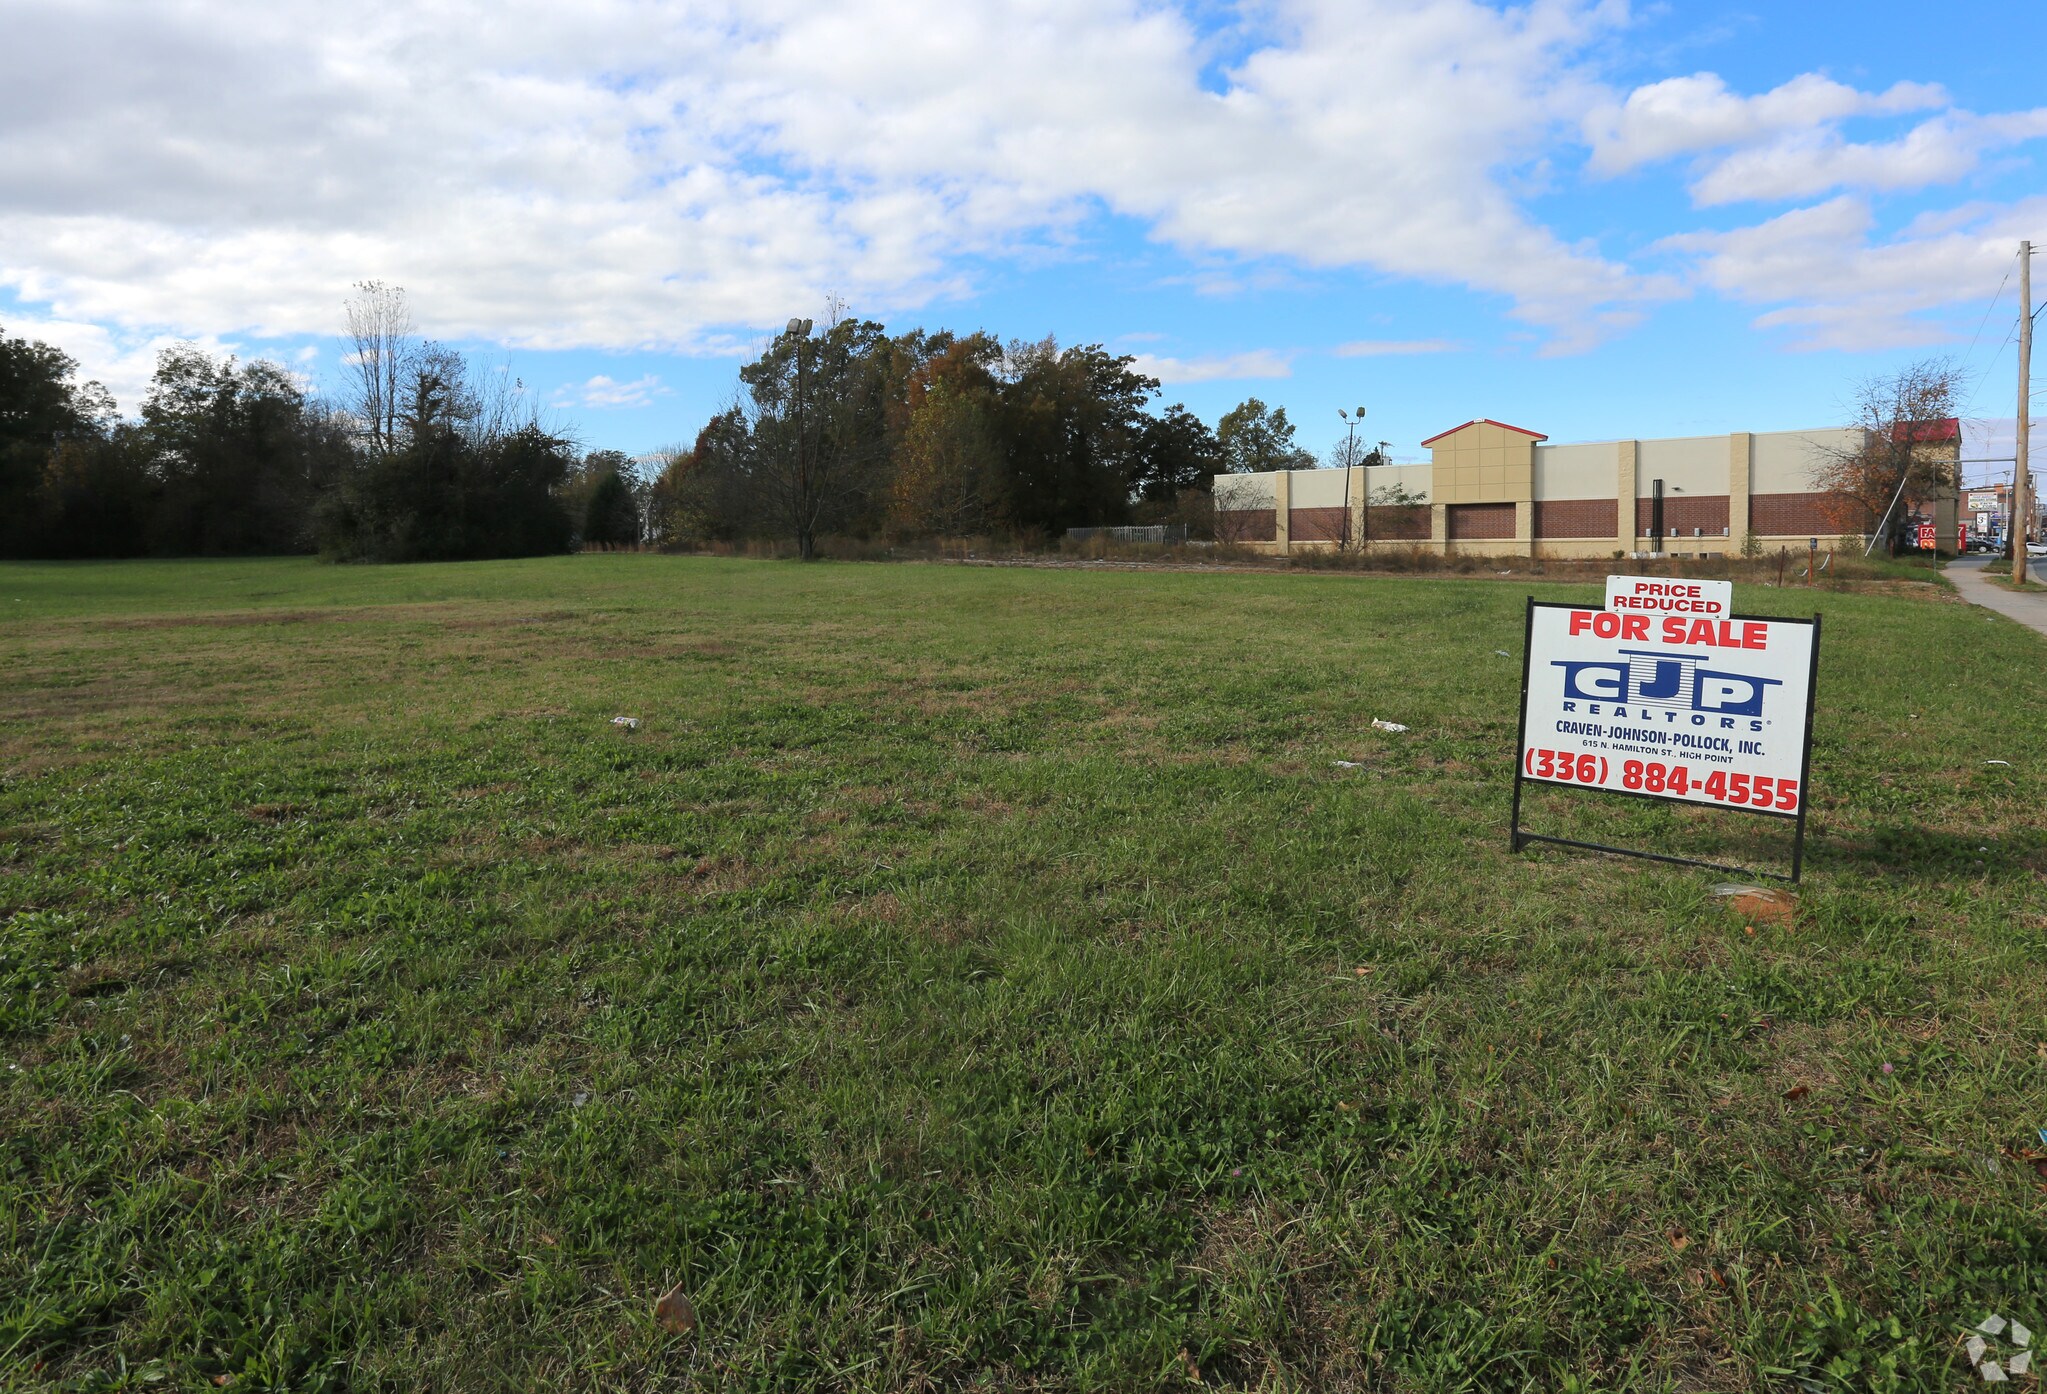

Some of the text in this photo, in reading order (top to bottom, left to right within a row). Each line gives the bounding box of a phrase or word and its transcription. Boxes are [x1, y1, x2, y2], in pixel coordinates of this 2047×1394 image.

[1613, 596, 1722, 613] REDUCED
[1635, 583, 1701, 597] PRICE
[1569, 611, 1767, 649] FOR SALE
[1572, 660, 1755, 709] CJP
[1556, 720, 1766, 756] CRAVEN-JOHNSON-POLLOCK, INC.
[1582, 739, 1598, 748] 615
[1612, 743, 1659, 755] HAMILTON
[1679, 751, 1702, 761] HIGH
[1704, 754, 1734, 764] POINT
[1525, 747, 1798, 811] (336) 884-4555
